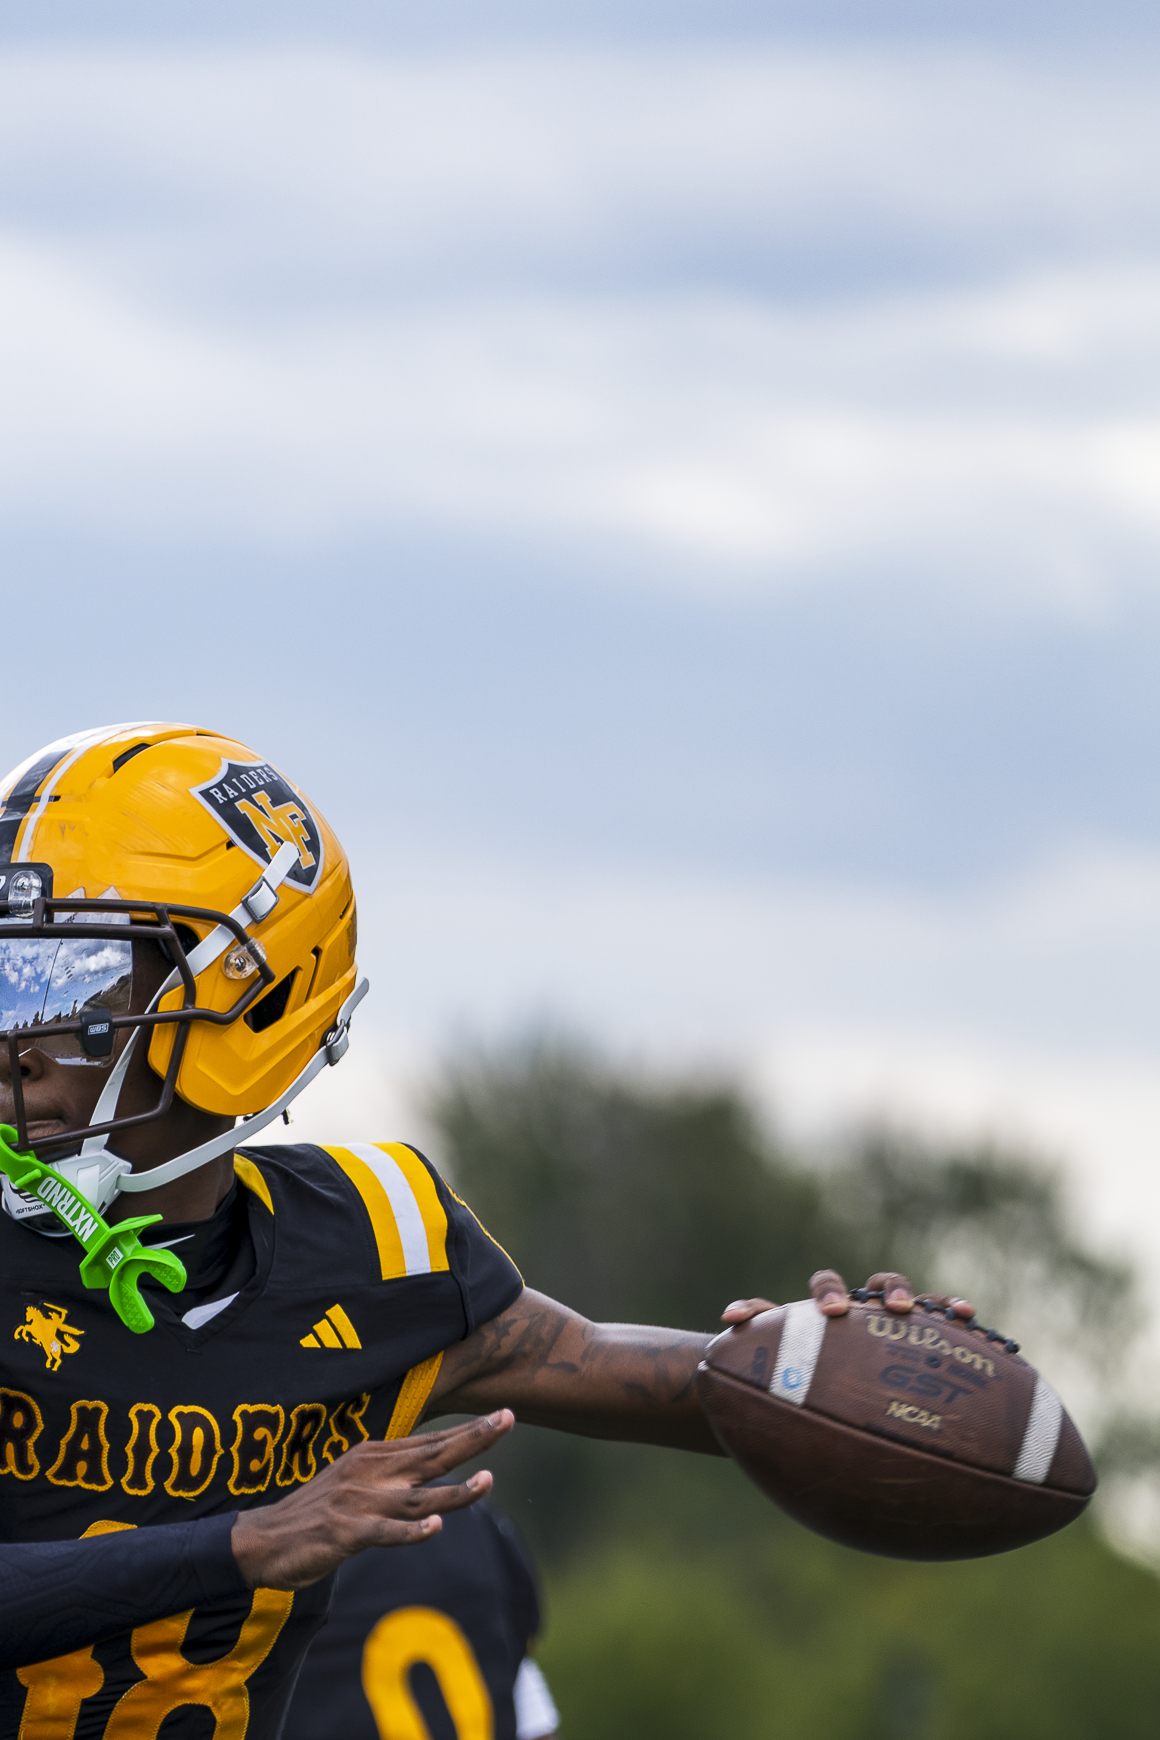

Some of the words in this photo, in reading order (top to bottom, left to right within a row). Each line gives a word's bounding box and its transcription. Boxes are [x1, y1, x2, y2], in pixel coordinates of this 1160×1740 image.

[209, 767, 278, 804] RAIDERS
[235, 789, 316, 870] NF
[37, 1176, 99, 1243] NXTRND
[107, 1249, 122, 1267] PRO
[866, 1313, 996, 1378] Wilson
[880, 1365, 973, 1404] GST
[885, 1400, 943, 1431] NCAA
